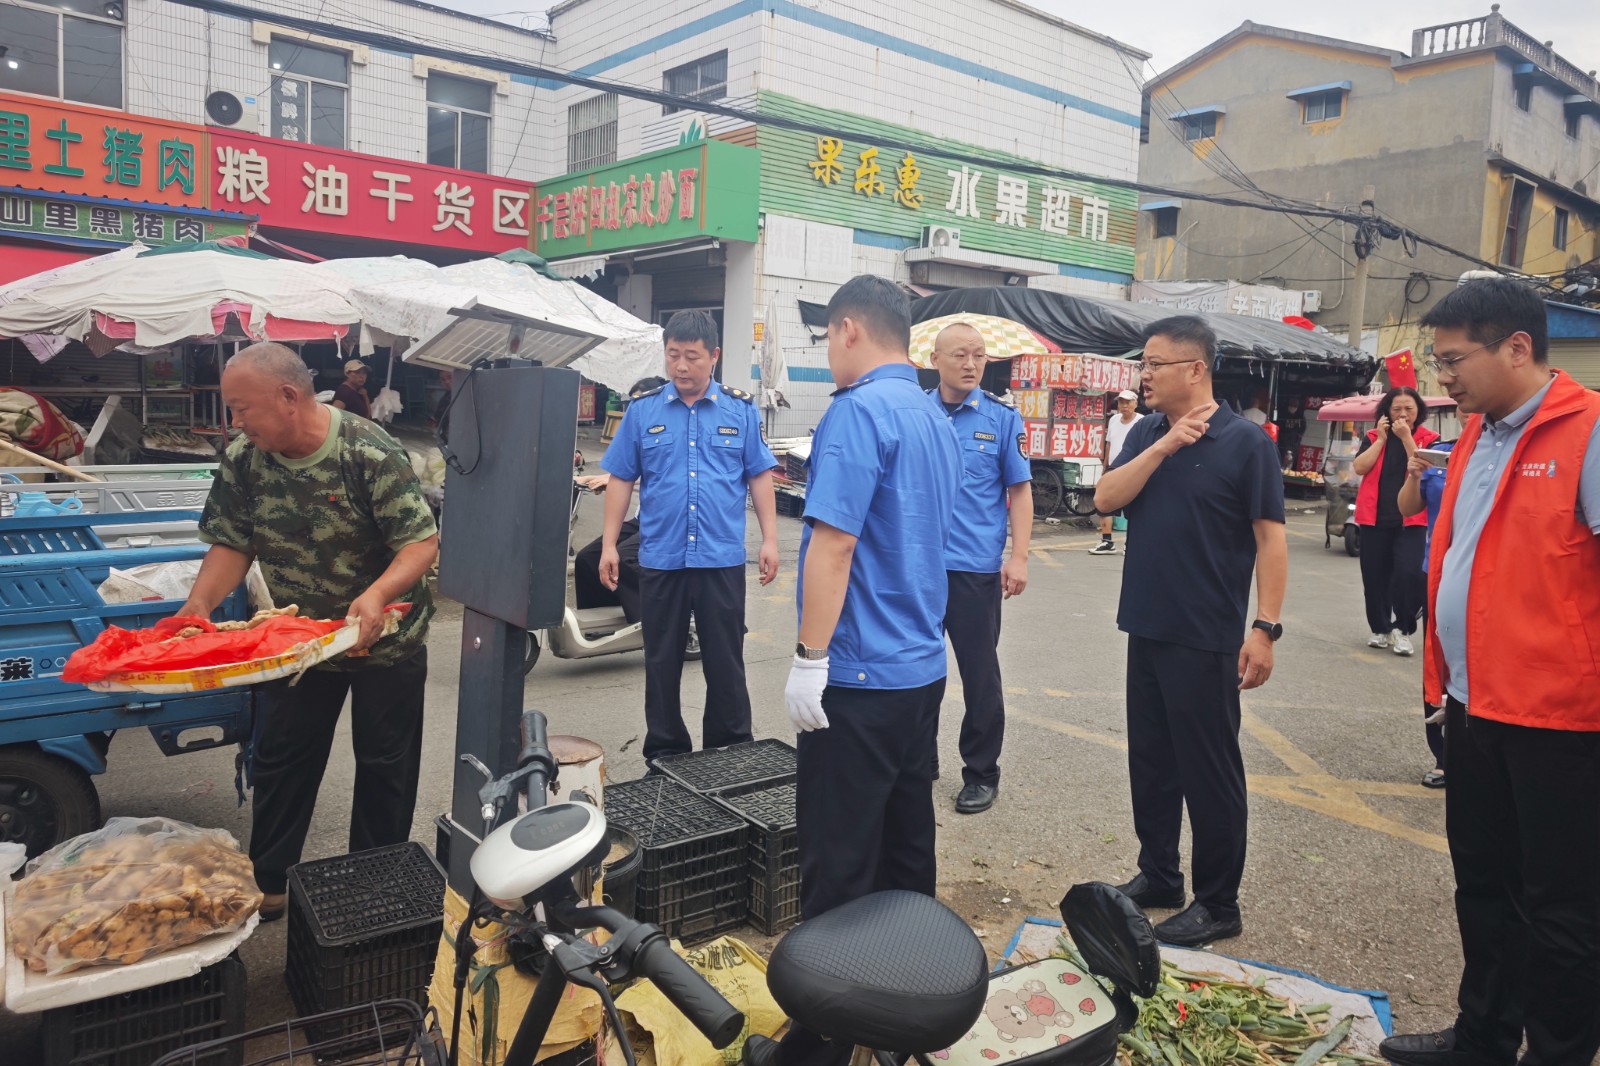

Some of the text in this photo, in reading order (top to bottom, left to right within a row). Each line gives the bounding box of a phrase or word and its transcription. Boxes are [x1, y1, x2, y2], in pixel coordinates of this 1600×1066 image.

[216, 146, 530, 237] 粮油干货区
[808, 136, 1110, 242] 果乐惠 水果超市
[0, 196, 205, 243] 山里黑猪肉
[1082, 357, 1135, 391] 专业炒面凉
[1024, 423, 1048, 456] 面
[1051, 423, 1104, 456] 蛋炒饭
